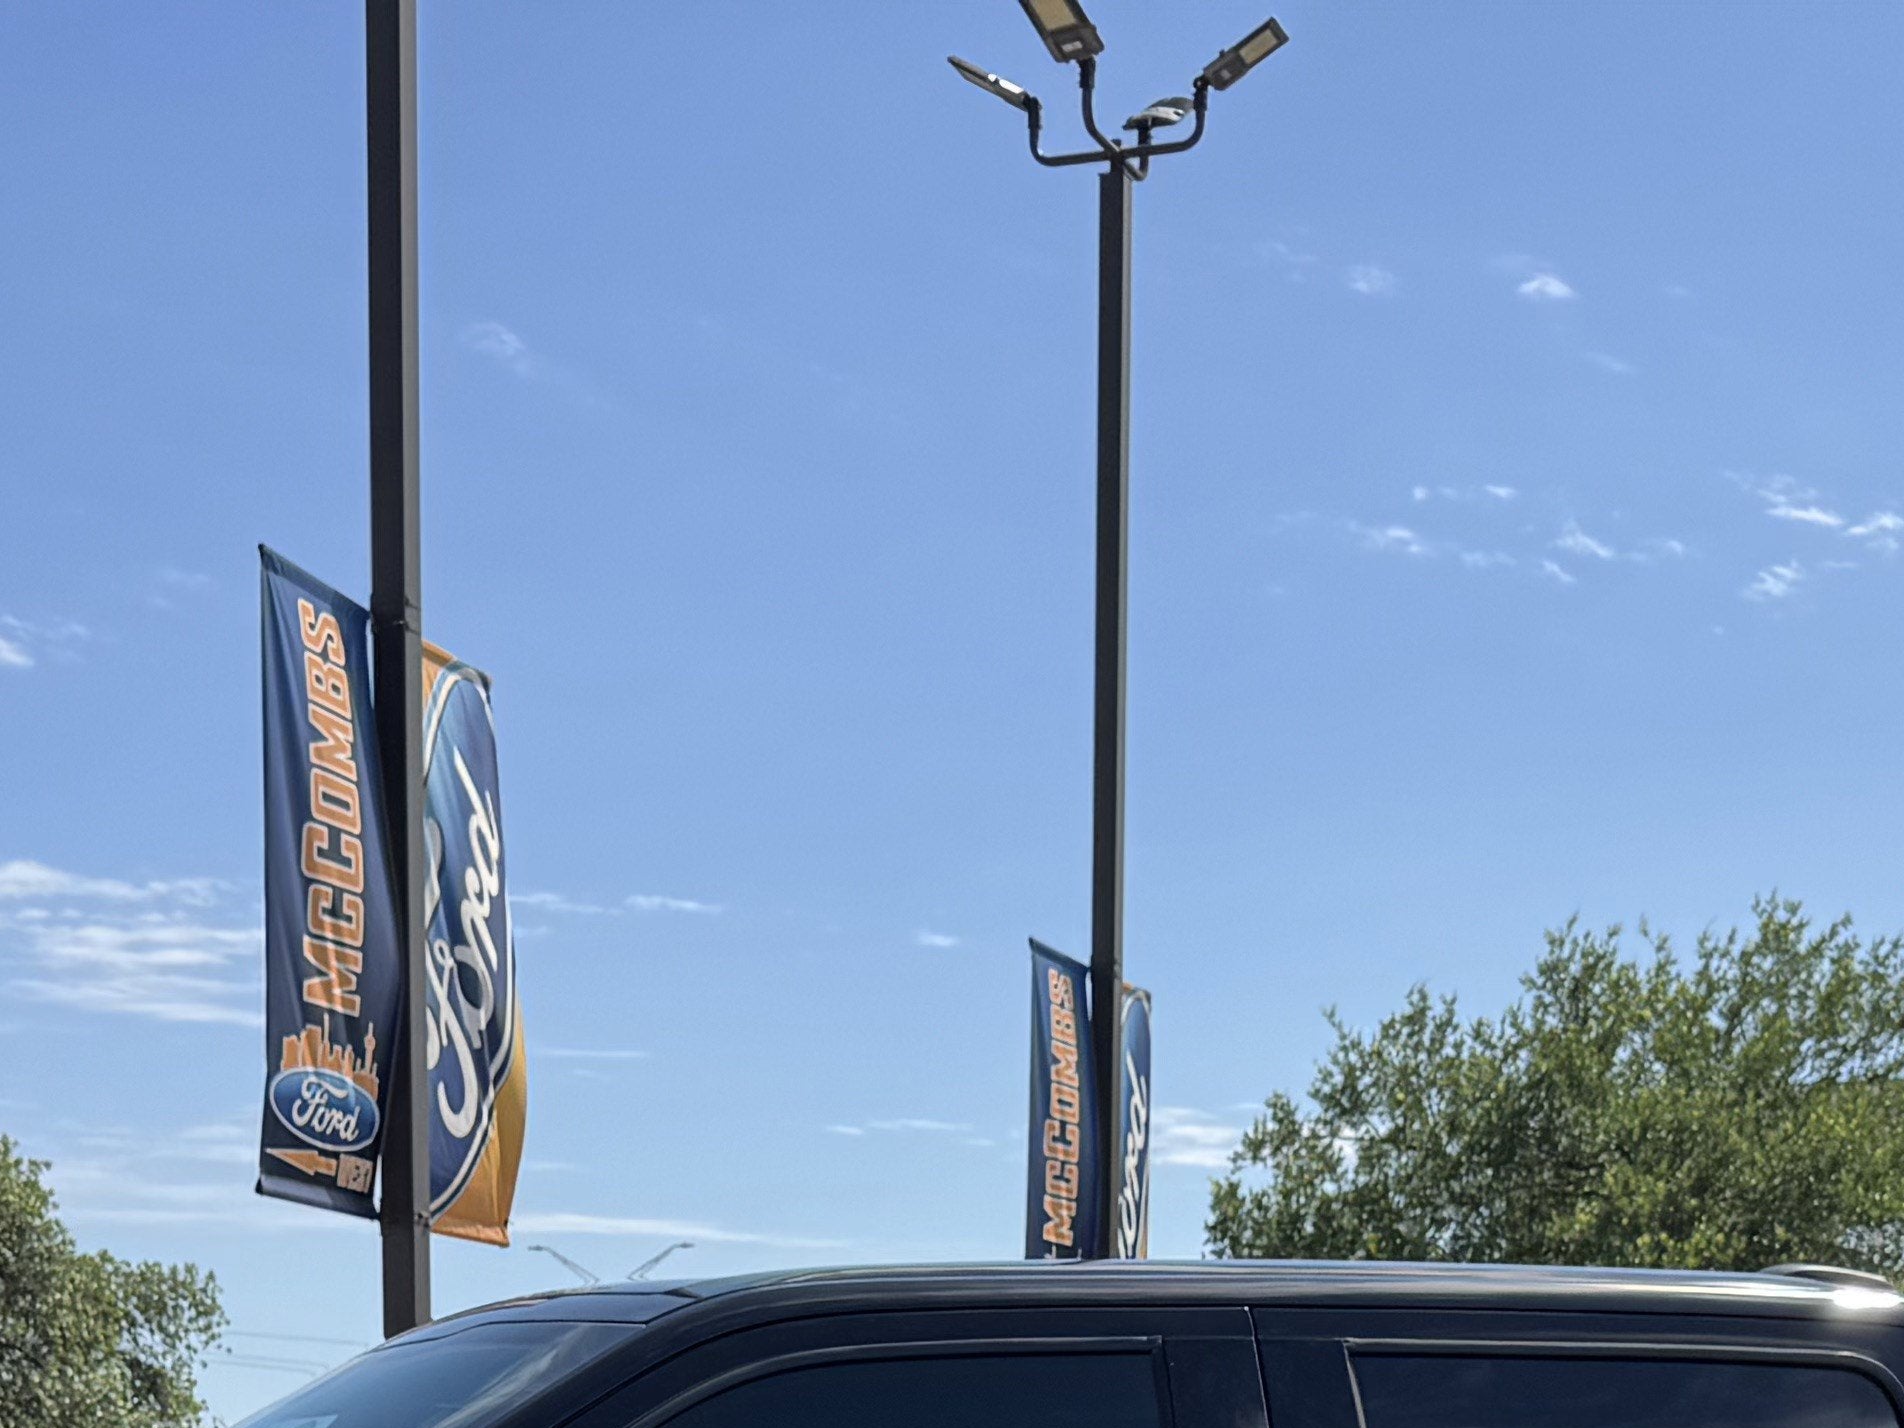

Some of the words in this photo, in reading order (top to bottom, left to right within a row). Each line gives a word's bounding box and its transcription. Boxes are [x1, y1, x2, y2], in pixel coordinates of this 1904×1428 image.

[297, 600, 363, 1018] MCCOMBS
[426, 746, 499, 1138] Ford
[292, 1076, 361, 1142] Ford
[1043, 968, 1079, 1247] MCCOMBS
[1118, 1050, 1147, 1259] ord
